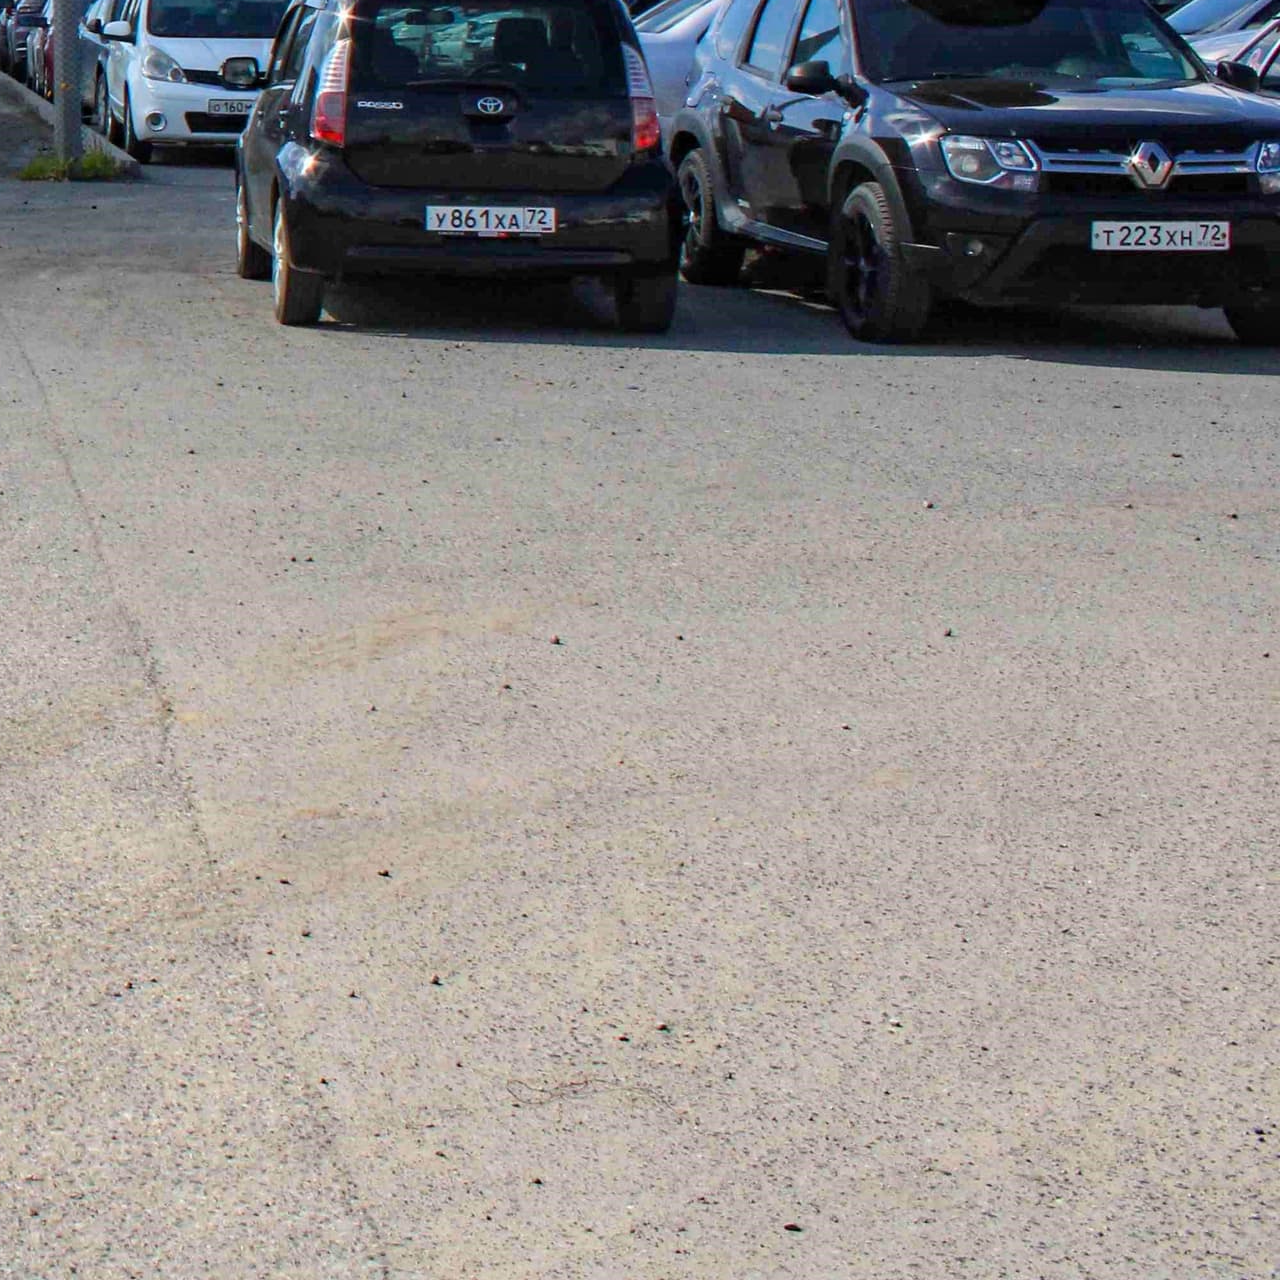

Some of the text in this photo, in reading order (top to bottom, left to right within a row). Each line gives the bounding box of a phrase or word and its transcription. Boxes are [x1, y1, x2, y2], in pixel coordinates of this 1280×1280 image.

[435, 209, 548, 230] У861ХА 72
[1102, 224, 1221, 246] Т223ХН 72
